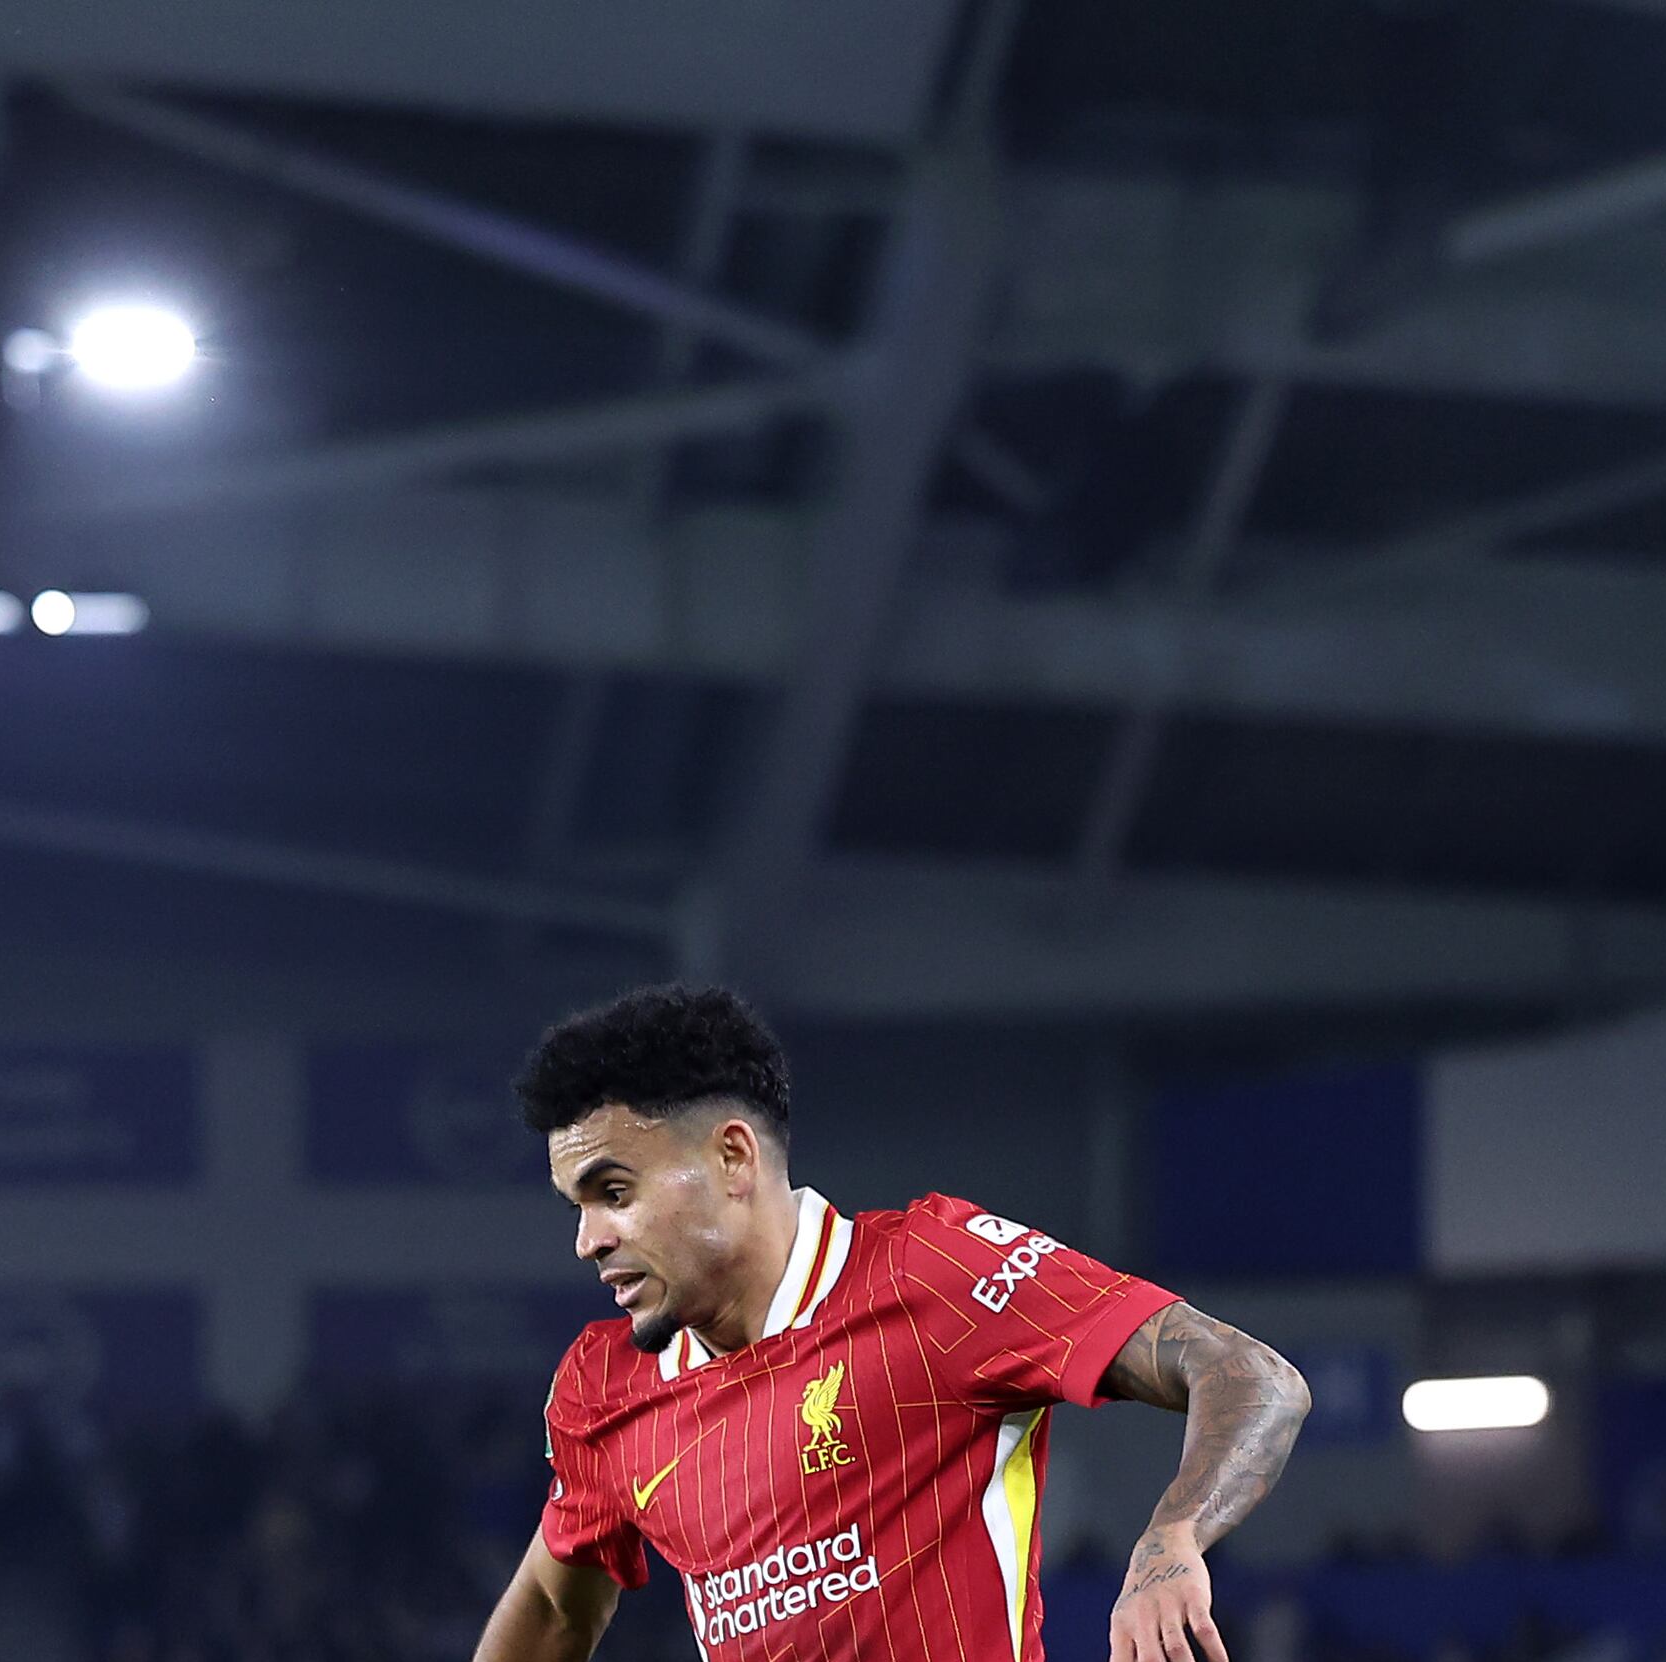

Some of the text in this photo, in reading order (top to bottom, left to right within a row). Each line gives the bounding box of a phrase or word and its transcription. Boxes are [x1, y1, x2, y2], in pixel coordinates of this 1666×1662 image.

[801, 1444, 856, 1475] L.F.C.
[705, 1522, 862, 1610] standard
[708, 1555, 880, 1646] chartered
